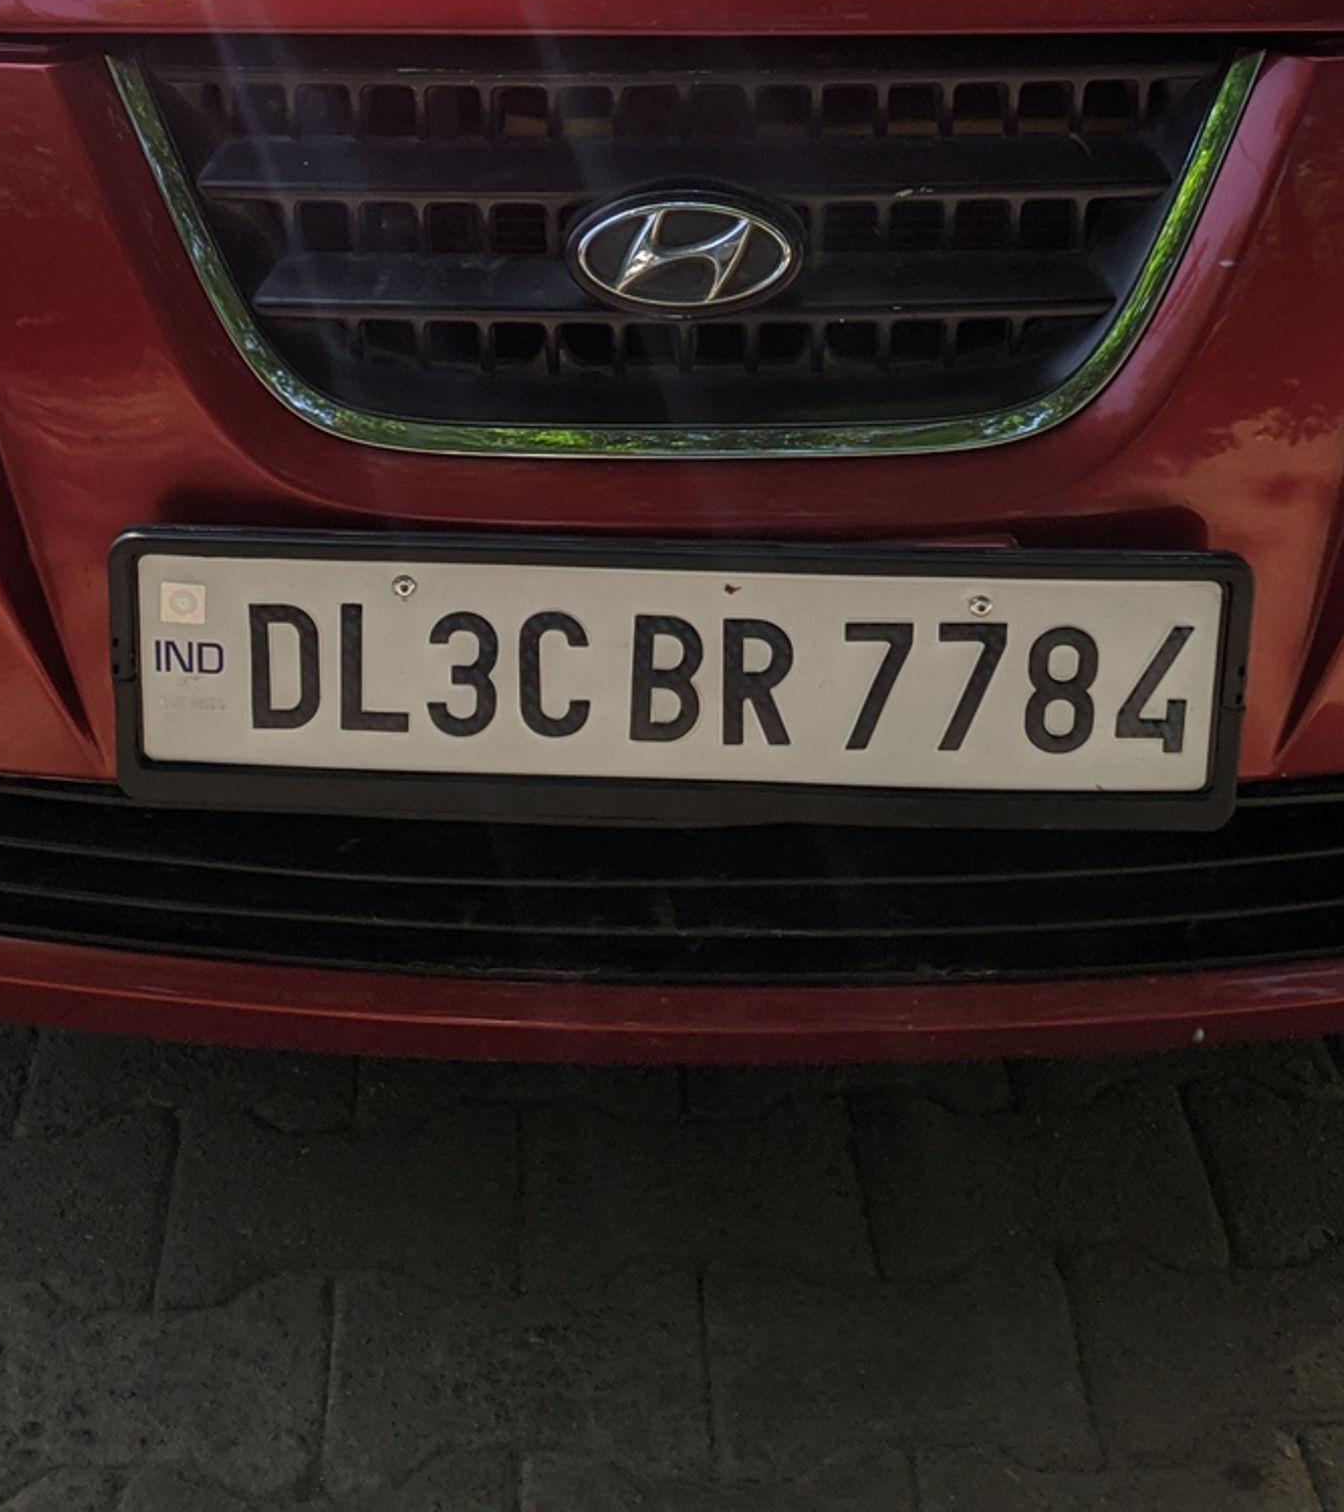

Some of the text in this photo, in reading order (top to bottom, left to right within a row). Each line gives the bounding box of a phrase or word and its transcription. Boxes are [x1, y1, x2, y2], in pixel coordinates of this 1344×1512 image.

[154, 639, 225, 675] IND
[248, 602, 1195, 755] DL3C BR 7784
